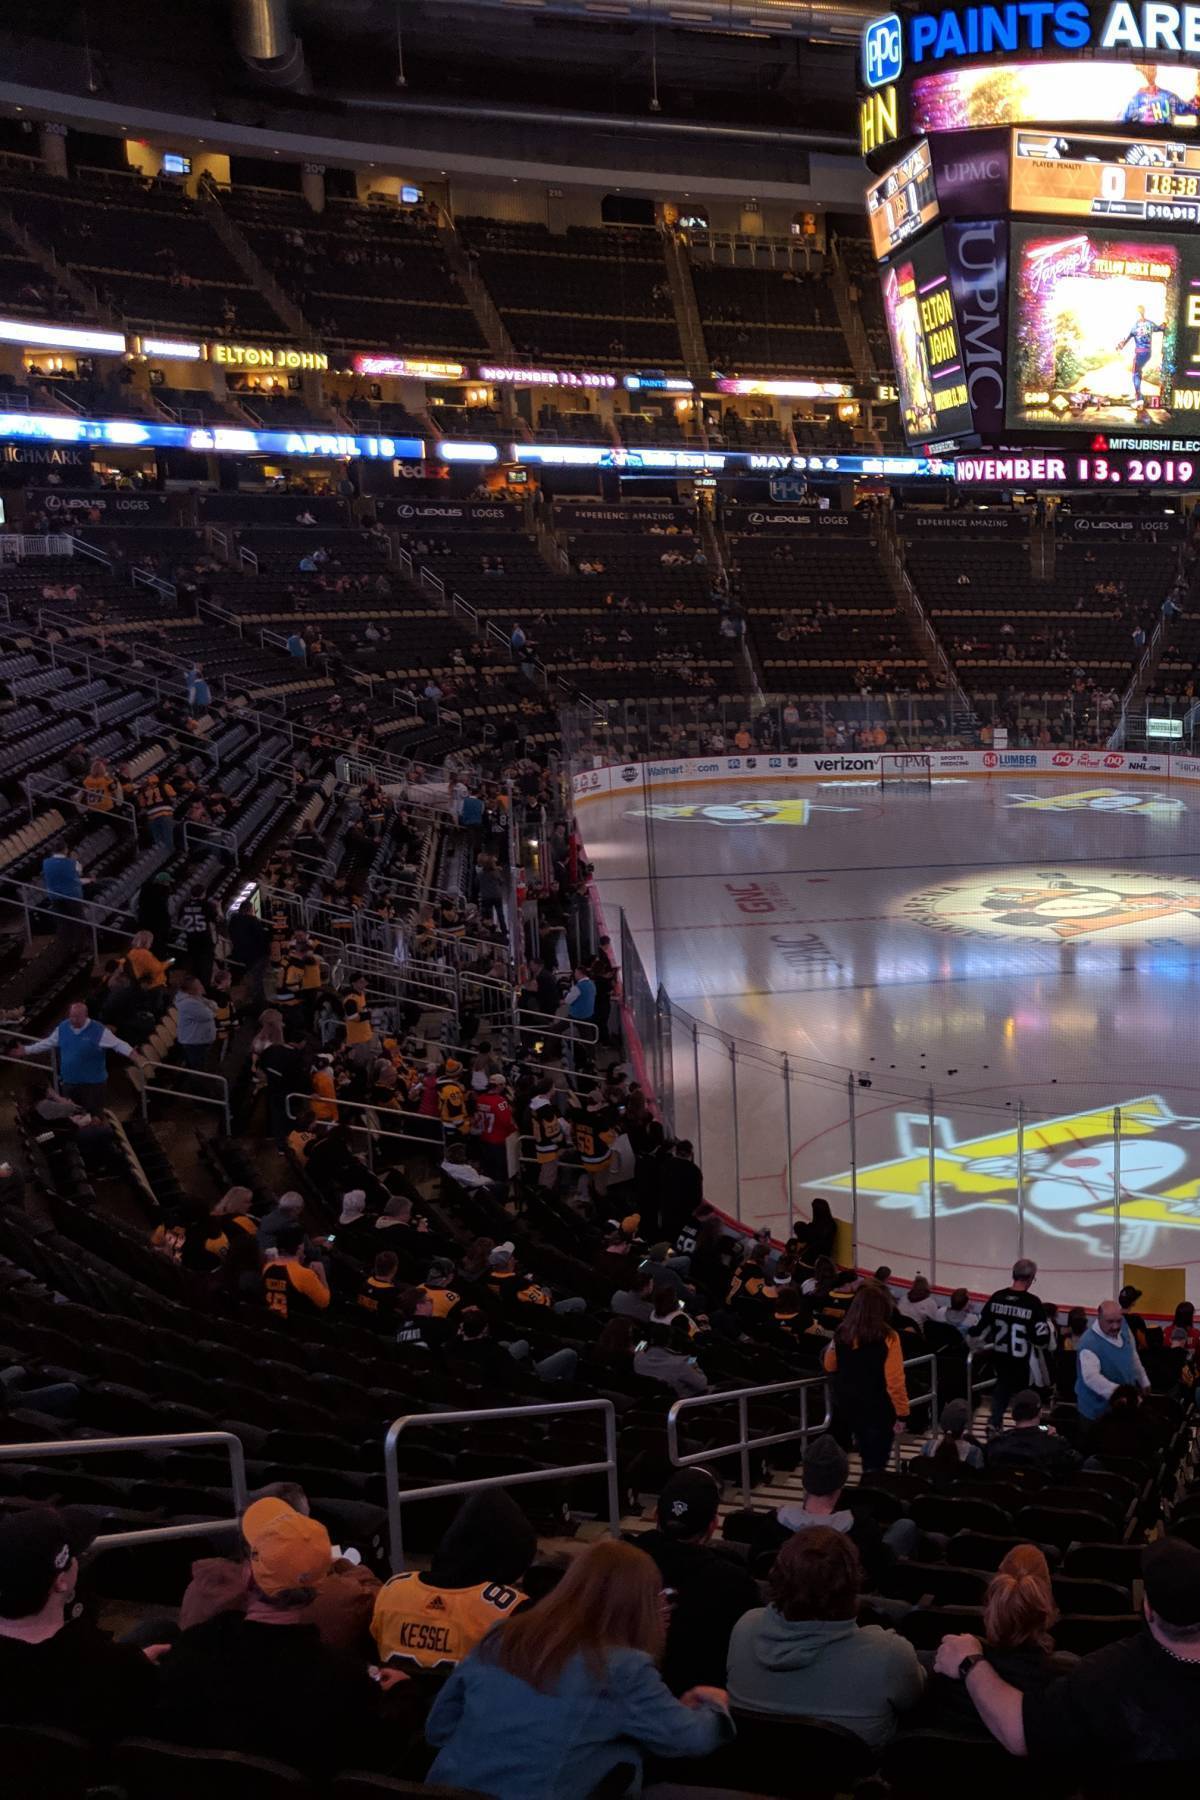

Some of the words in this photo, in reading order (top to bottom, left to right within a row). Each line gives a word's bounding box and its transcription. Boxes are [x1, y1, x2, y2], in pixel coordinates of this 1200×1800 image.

[911, 2, 1091, 62] PAINTS
[868, 27, 899, 77] PPG
[944, 161, 1000, 182] UPMC
[1056, 162, 1082, 170] PENALTY
[1101, 167, 1126, 200] 0
[1151, 175, 1198, 197] 18:38
[921, 290, 954, 333] ELTON
[958, 224, 1004, 411] UPMC
[929, 326, 957, 366] JOHN
[216, 346, 274, 366] ELTON
[277, 351, 329, 370] JOHN
[483, 366, 559, 385] NOVEMBER
[584, 373, 616, 387] 2019
[287, 434, 361, 456] APRIL
[369, 436, 396, 458] 18
[1110, 439, 1170, 451] MITSUBISHI
[393, 460, 450, 479] FedEx
[751, 455, 792, 470] MAY
[792, 457, 807, 470] 3
[824, 458, 840, 470] 4
[957, 459, 1066, 481] NOVEMBER
[1128, 461, 1193, 482] 2019
[62, 500, 107, 508] LEXUS
[116, 501, 150, 511] LOGES
[416, 508, 463, 517] LEXUS
[472, 509, 505, 518] LOGES
[576, 511, 629, 520] EXPERIENCE
[633, 511, 675, 520] AMAZING
[766, 515, 811, 524] LEXUS
[819, 515, 849, 525] LOGES
[917, 518, 967, 527] EXPERIENCE
[970, 519, 1008, 528] AMAZING
[1091, 521, 1134, 530] LEXUS
[1141, 521, 1169, 531] LOGES
[814, 757, 875, 772] verizon
[894, 755, 936, 768] UPMC
[1000, 754, 1037, 765] LUMBER
[647, 765, 684, 777] Walmart
[993, 1318, 1028, 1359] 26
[400, 1622, 453, 1653] KESSEL
